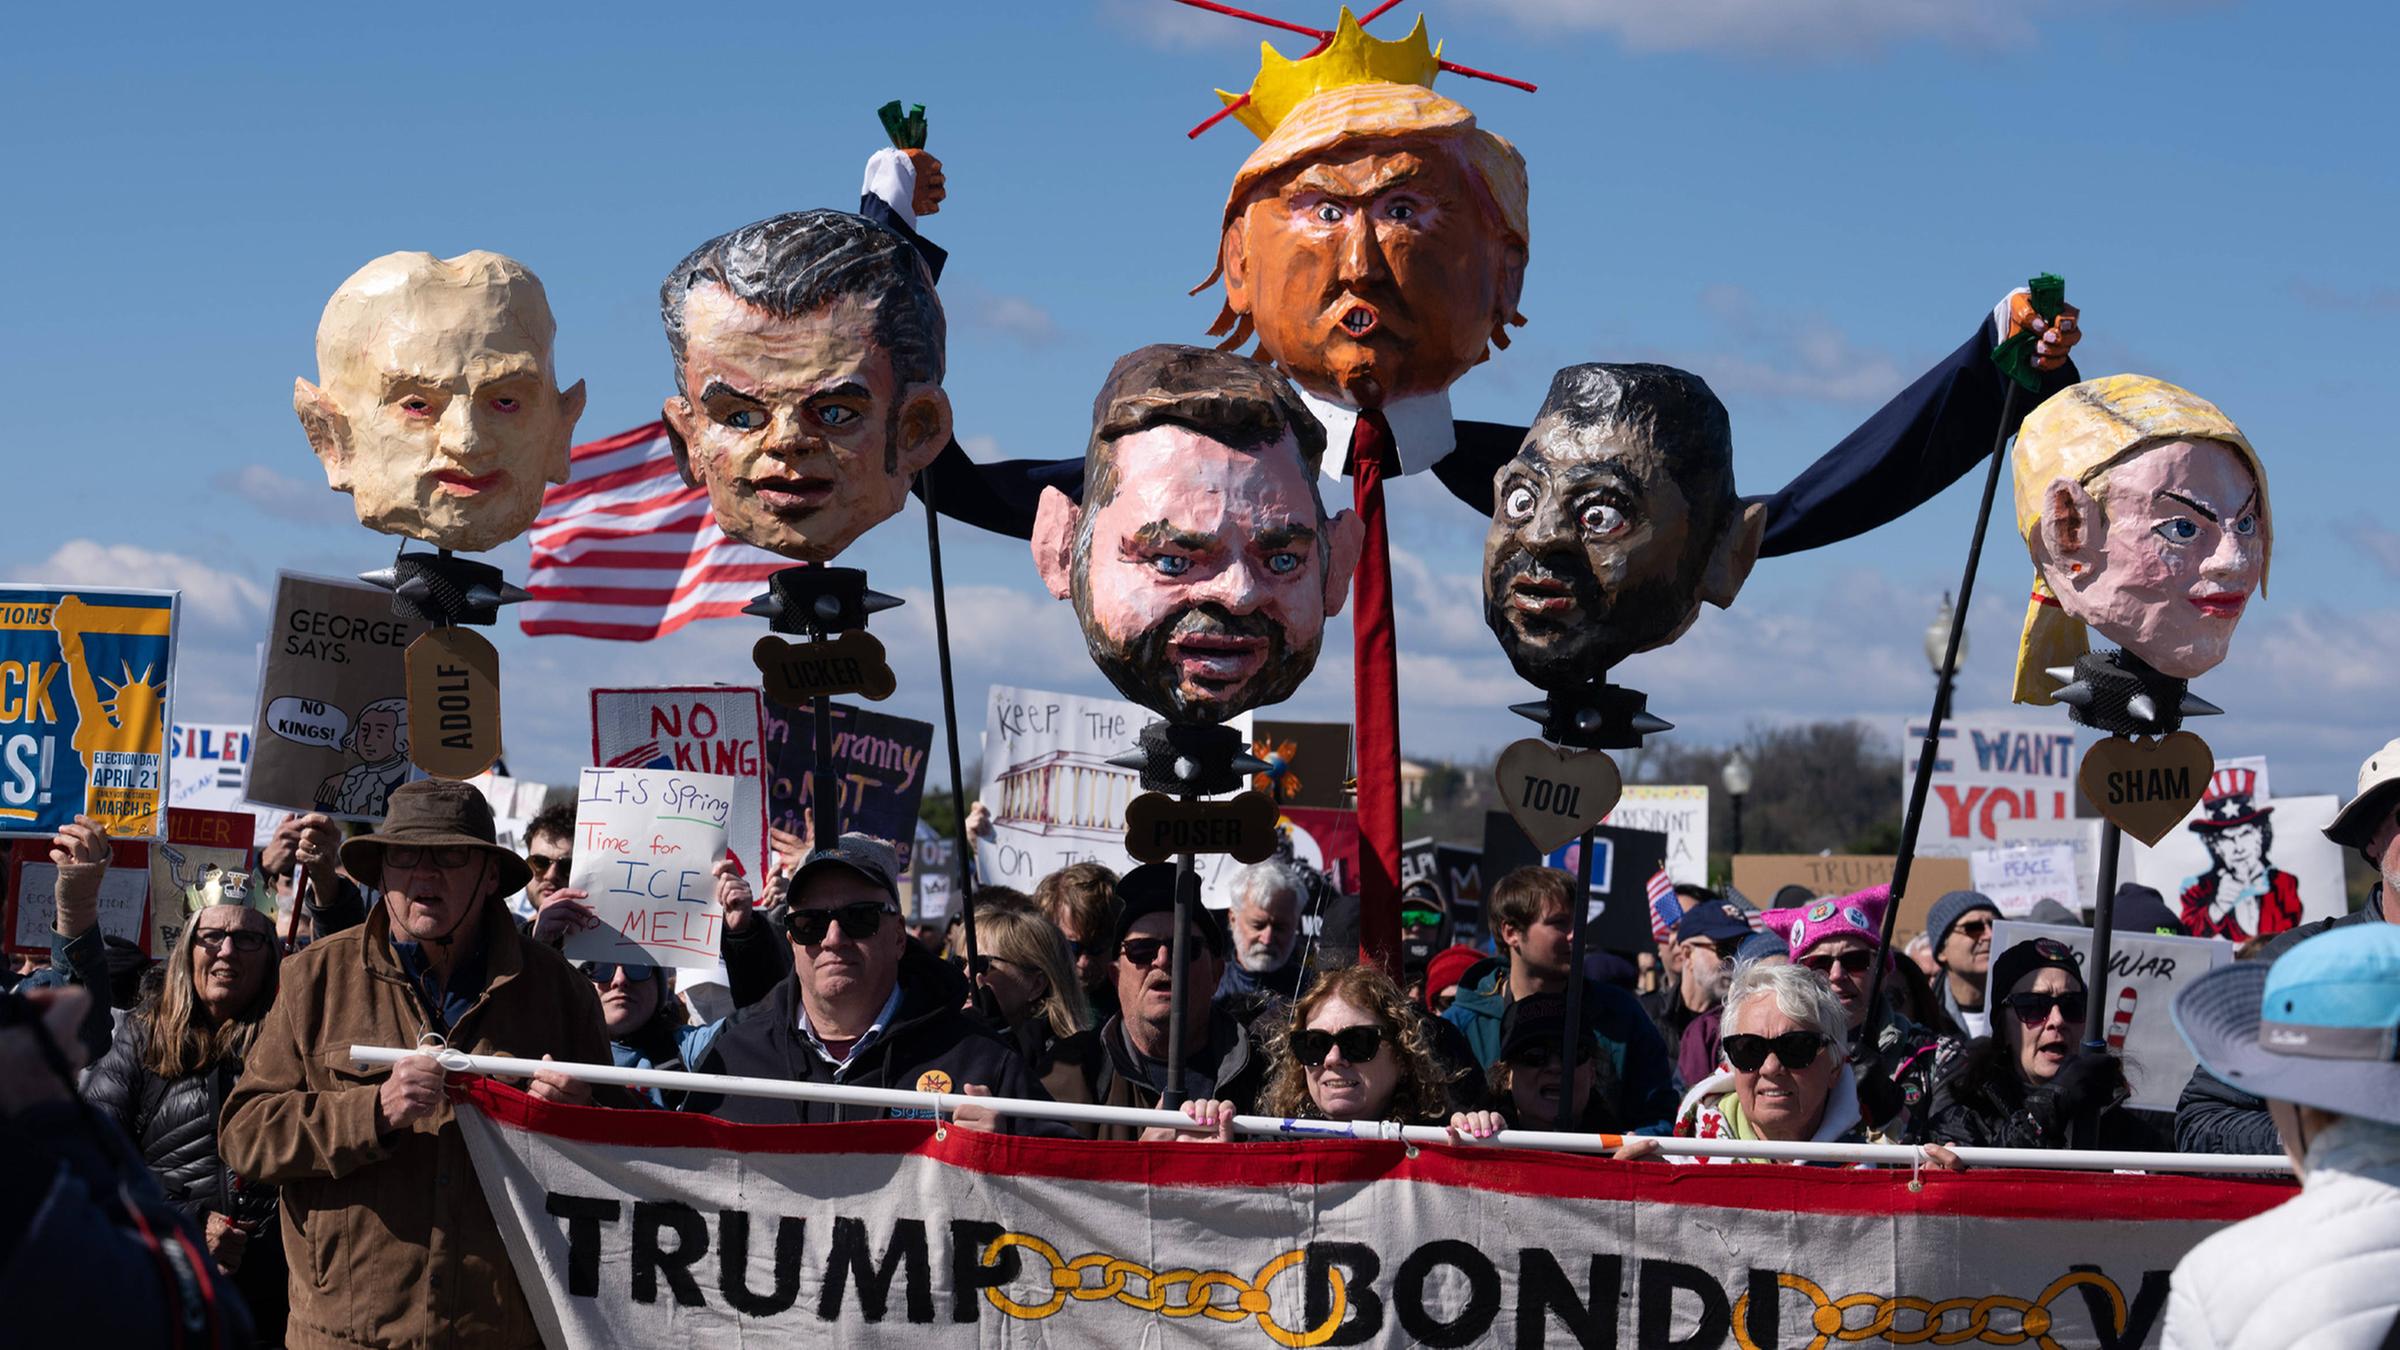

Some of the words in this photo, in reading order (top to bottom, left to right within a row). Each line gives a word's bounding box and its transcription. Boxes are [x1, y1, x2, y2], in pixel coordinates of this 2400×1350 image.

[290, 609, 408, 647] GEORGE
[285, 635, 350, 664] SAYS,
[782, 657, 864, 689] LICKER
[300, 700, 326, 717] NO
[437, 664, 473, 749] ADOLF
[651, 702, 717, 739] NO
[278, 719, 336, 740] KINGS!
[94, 752, 137, 766] ELECTION
[140, 754, 159, 767] DAY
[675, 739, 757, 776] KING
[798, 705, 923, 794] ranny
[1970, 729, 2074, 778] WANT
[0, 733, 56, 804] S!
[93, 767, 135, 788] APRIL
[140, 770, 158, 788] 21
[2108, 766, 2191, 804] SHAM
[95, 800, 139, 816] MARCH
[142, 801, 152, 816] 6
[1521, 775, 1580, 820] TOOL
[578, 822, 630, 854] Time
[650, 834, 681, 855] for
[1154, 818, 1243, 848] POSER
[998, 845, 1032, 877] On
[2003, 859, 2054, 878] PEACE
[609, 861, 707, 905] ICE
[620, 910, 722, 945] MELT
[2108, 950, 2175, 980] WAR
[546, 1191, 1021, 1324] TRUMP
[1304, 1239, 1781, 1350] BONDI
